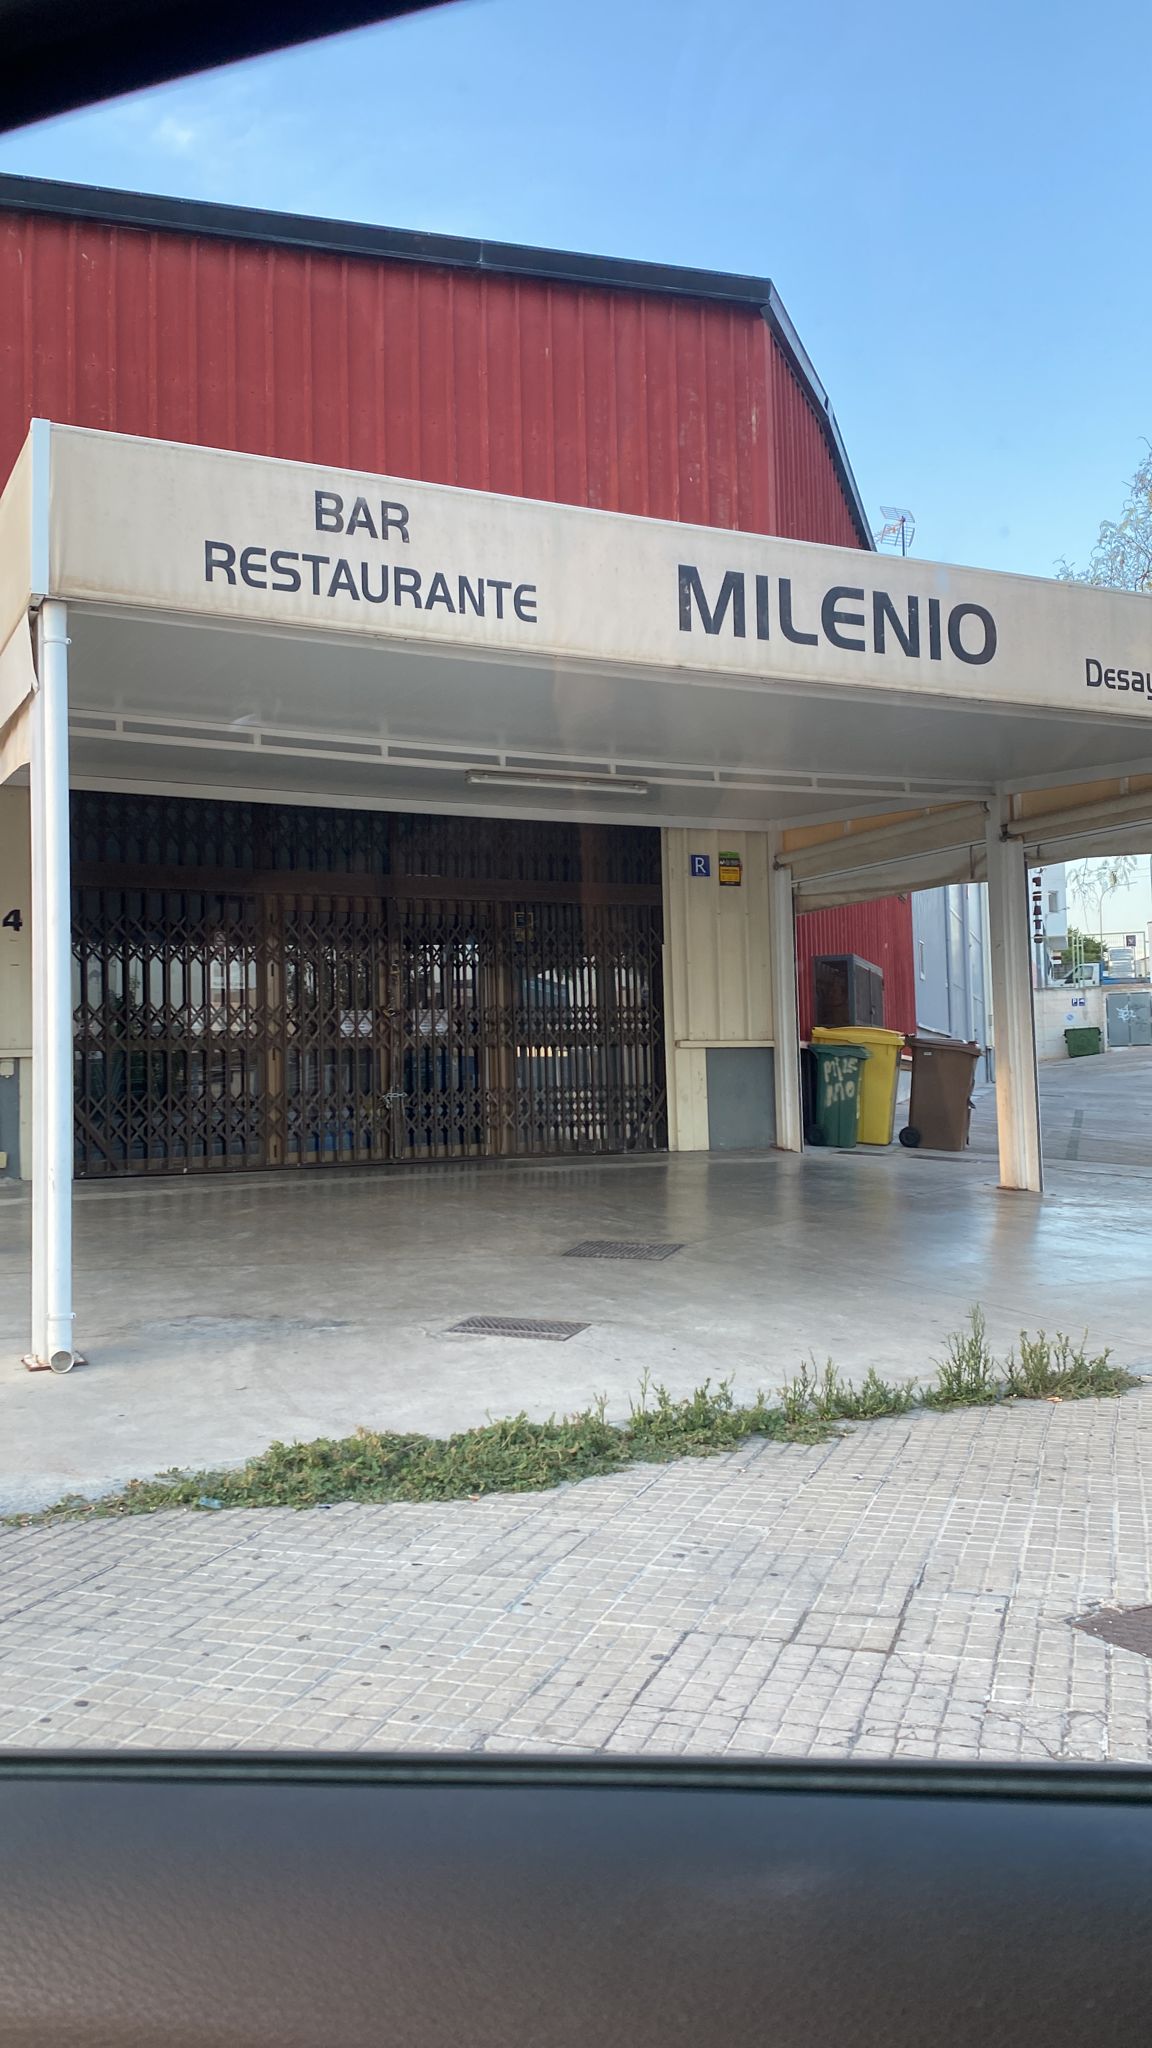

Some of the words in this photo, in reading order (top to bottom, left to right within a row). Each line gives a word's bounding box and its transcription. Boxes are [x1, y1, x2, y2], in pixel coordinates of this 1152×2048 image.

[314, 490, 410, 543] BAR
[204, 540, 538, 623] RESTAURANTE
[677, 564, 997, 665] MILENIO
[2, 909, 23, 932] 4
